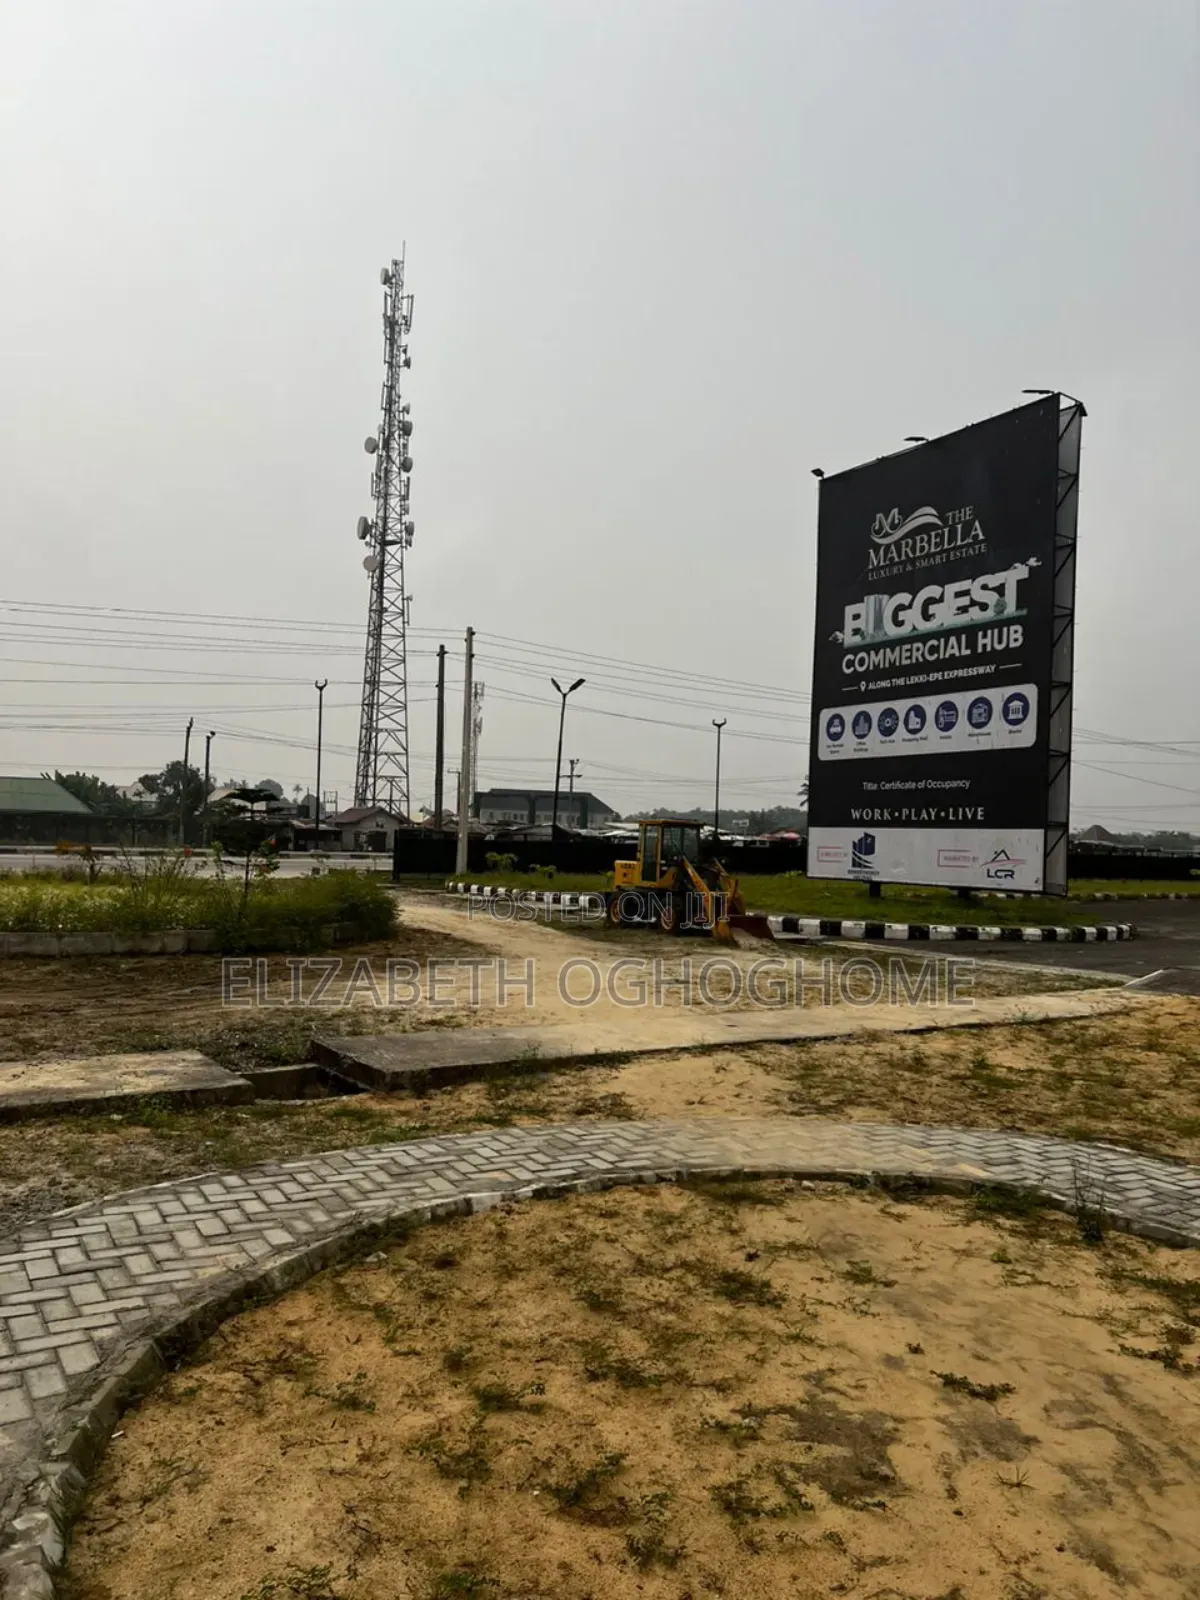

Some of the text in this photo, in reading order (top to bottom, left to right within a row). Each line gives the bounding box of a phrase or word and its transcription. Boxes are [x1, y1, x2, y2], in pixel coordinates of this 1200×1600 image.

[946, 505, 974, 524] THE
[868, 520, 986, 570] MARBELLA
[868, 543, 987, 581] LUXURY & SMART ESTATE
[844, 566, 1029, 645] BIGGEST
[842, 624, 1024, 675] COMMERCIAL HUB
[868, 664, 996, 690] ALONG THE LEKKI-EPE EXPRESSWAY
[880, 780, 916, 790] Certificate
[917, 780, 926, 790] of
[926, 779, 971, 791] Occupancy
[986, 869, 1015, 880] LCR
